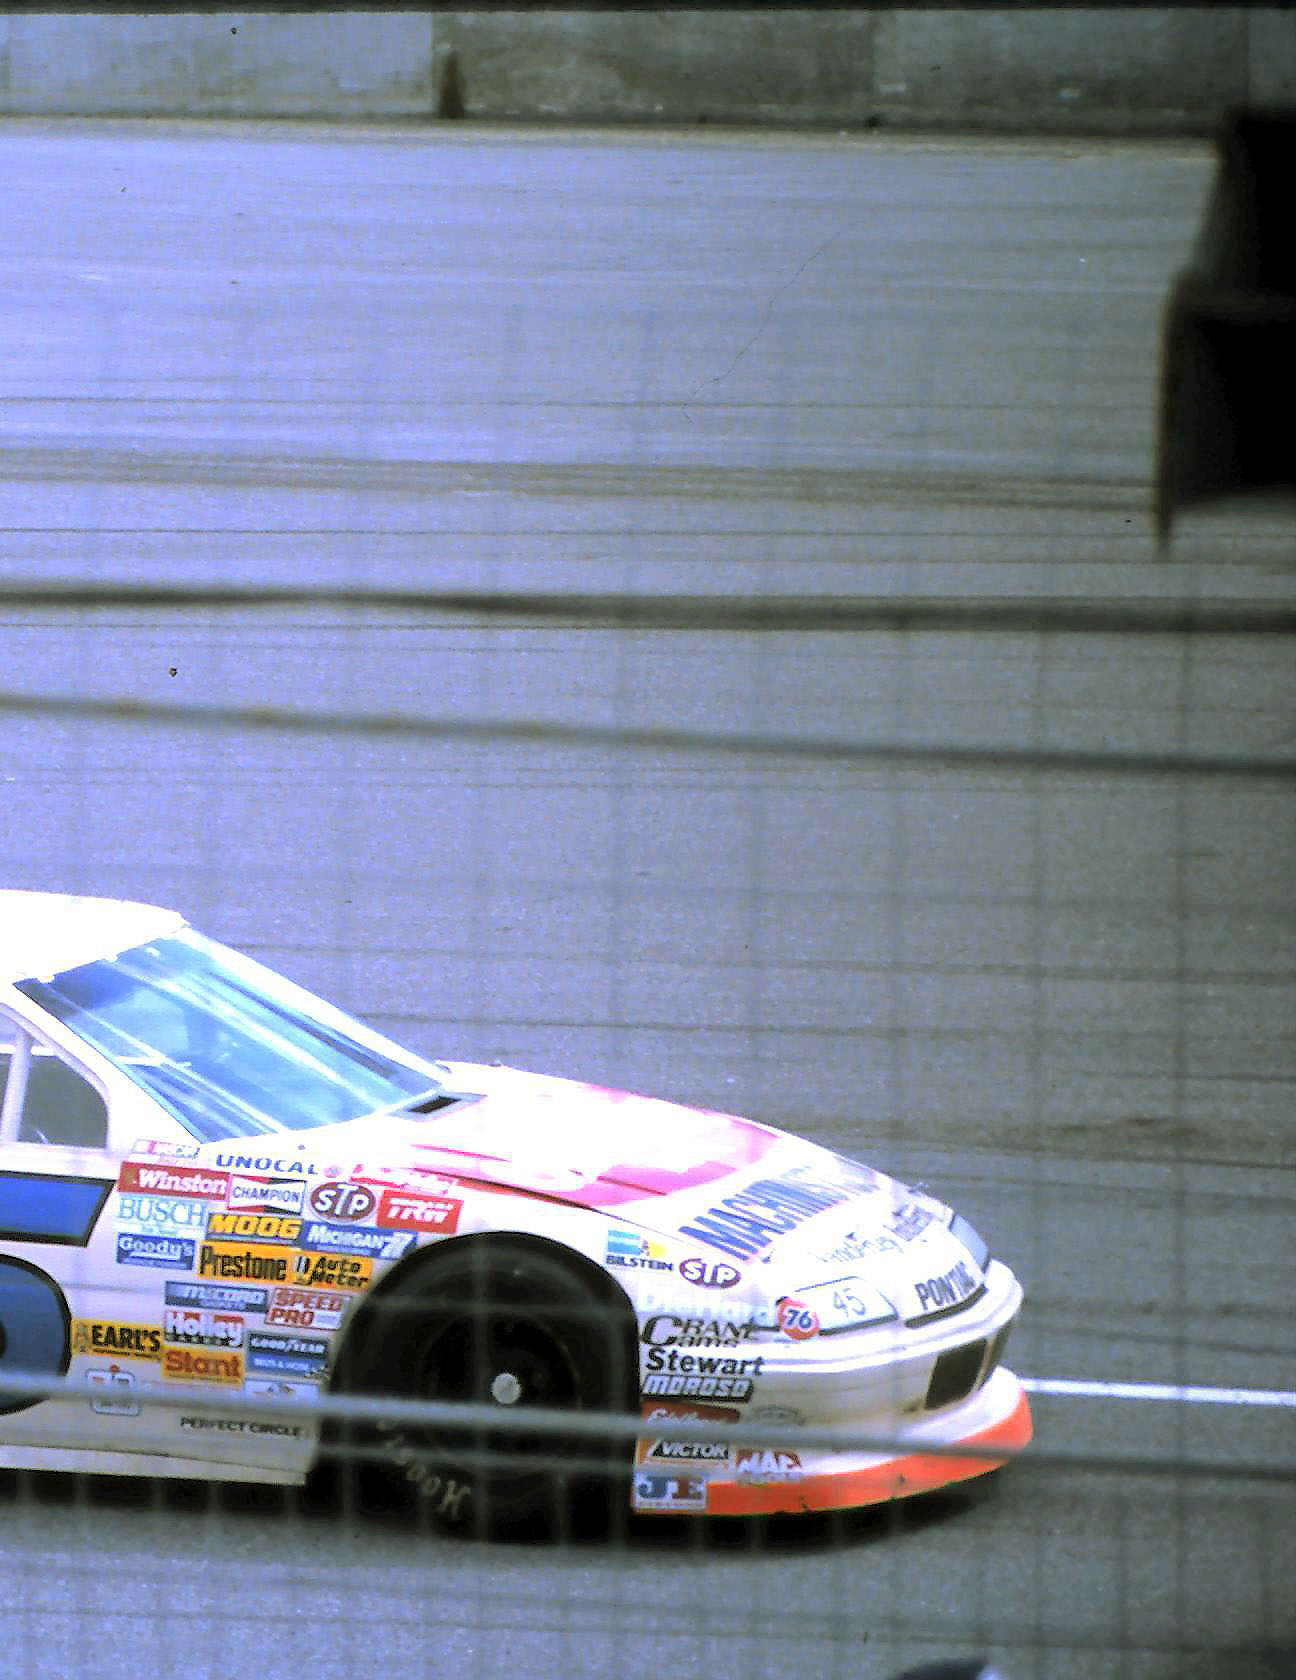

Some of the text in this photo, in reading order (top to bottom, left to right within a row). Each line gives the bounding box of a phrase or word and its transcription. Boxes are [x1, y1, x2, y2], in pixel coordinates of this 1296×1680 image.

[215, 1154, 319, 1176] UNOCAL
[137, 1168, 227, 1196] Winston
[231, 1185, 301, 1204] CHAMPION
[312, 1183, 371, 1217] STP
[116, 1197, 203, 1226] BUSCH
[385, 1196, 454, 1225] TRW
[206, 1213, 302, 1241] MOOG
[118, 1236, 194, 1259] Goody's
[200, 1246, 287, 1281] Prestone
[311, 1256, 362, 1274] Auto
[605, 1254, 674, 1273] BILSTEIN
[681, 1261, 736, 1284] STP
[309, 1269, 368, 1287] Meter
[275, 1289, 342, 1312] SPEED
[832, 1287, 867, 1319] 45
[270, 1306, 315, 1325] PRO
[786, 1308, 813, 1329] 76
[91, 1324, 162, 1352] EARL'S
[165, 1350, 242, 1380] Stant
[646, 1347, 765, 1376] Stewart
[643, 1374, 750, 1397] MOROSO
